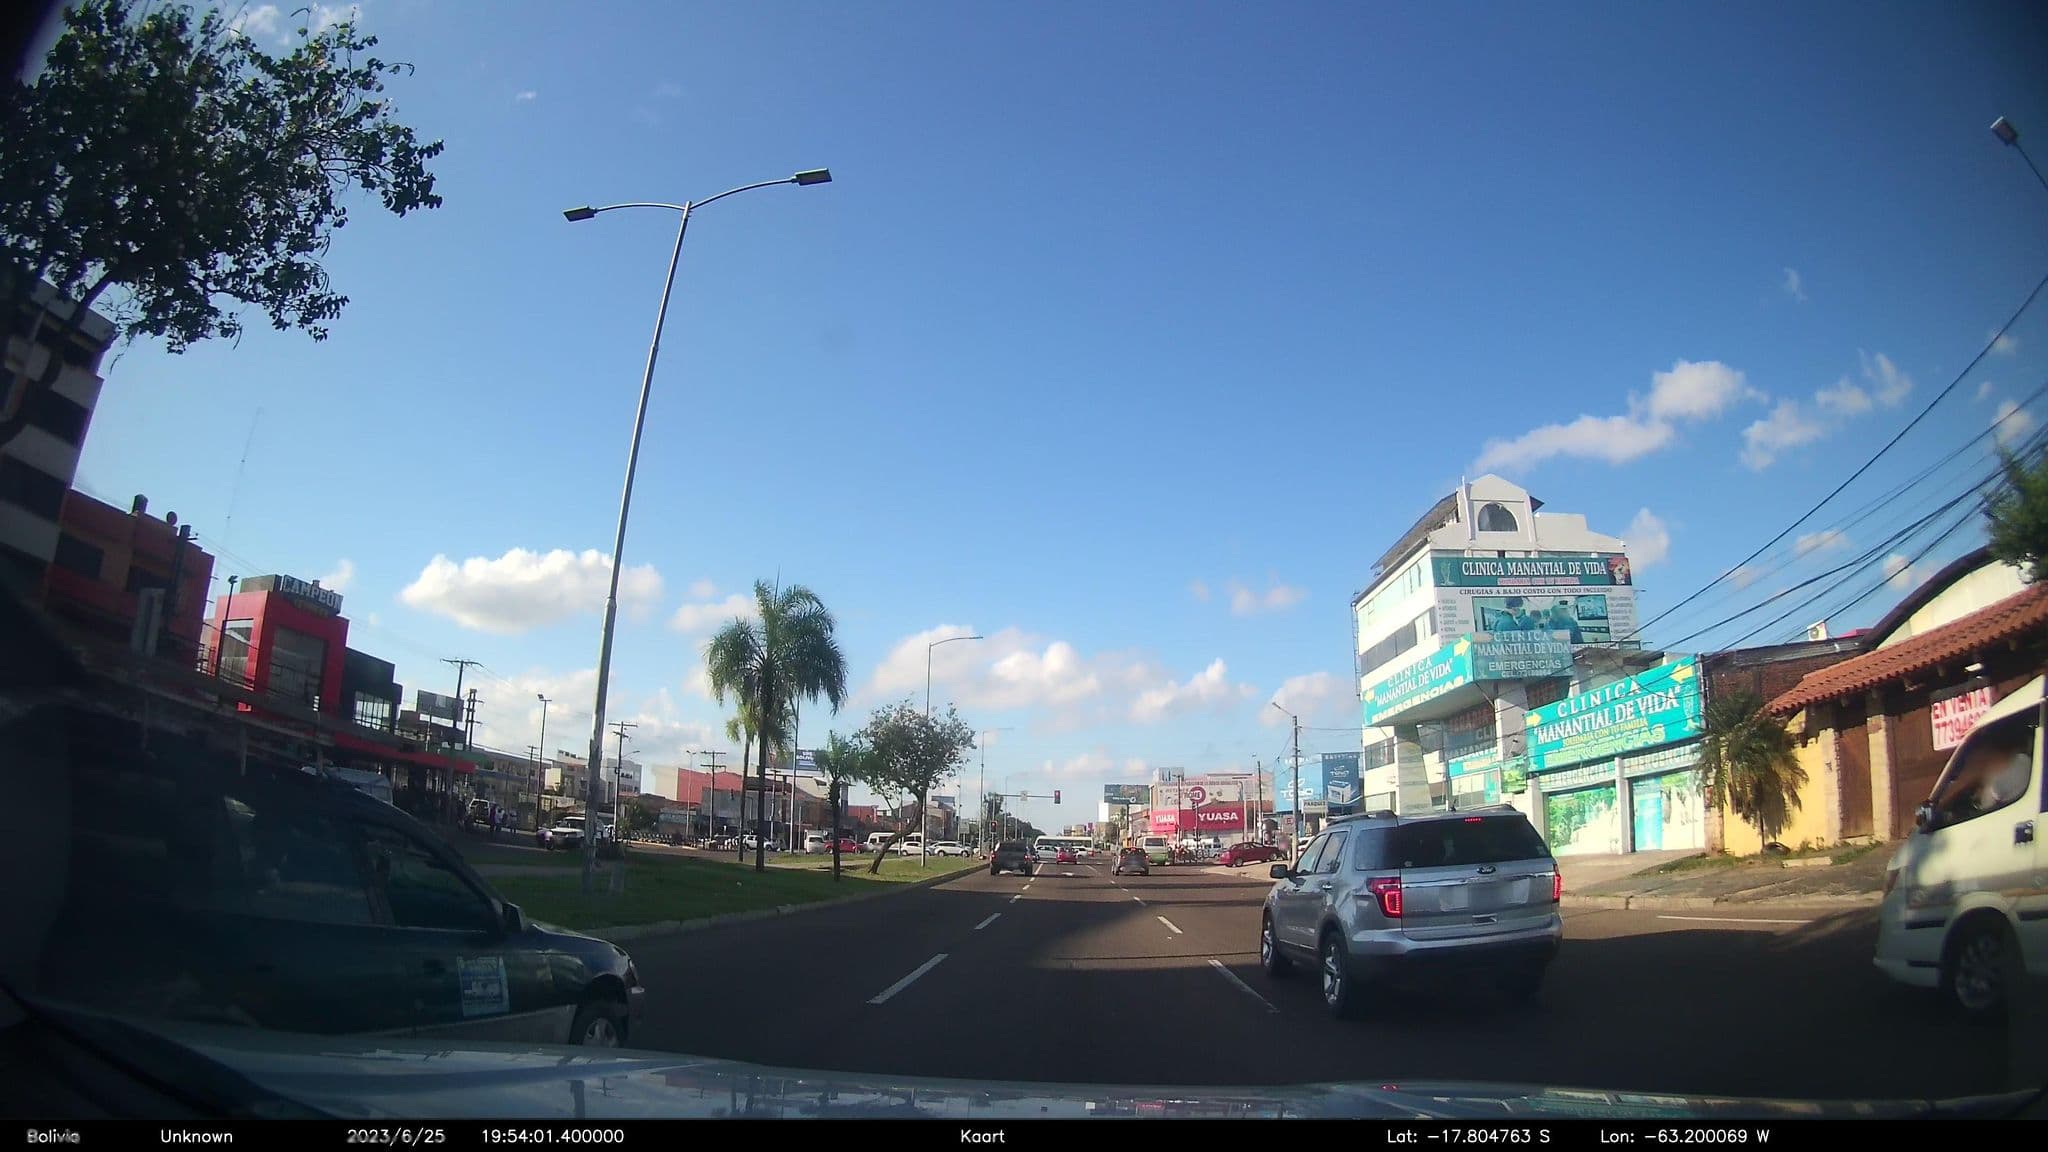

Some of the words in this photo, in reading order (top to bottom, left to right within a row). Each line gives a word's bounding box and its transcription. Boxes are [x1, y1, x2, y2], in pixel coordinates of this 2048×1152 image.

[1462, 561, 1504, 576] CLINICA
[1507, 561, 1566, 576] MANANTIAL
[1568, 561, 1582, 575] DE
[1584, 561, 1607, 575] VIDA
[1493, 631, 1549, 642] CLINICA
[1534, 643, 1549, 655] DE
[1388, 656, 1433, 688] CLINICA
[1488, 660, 1562, 672] EMERGENCIAS
[1557, 680, 1642, 718] CLINICA
[1615, 701, 1636, 723] DE
[1933, 703, 1947, 720] EN
[1198, 812, 1239, 822] YUASA
